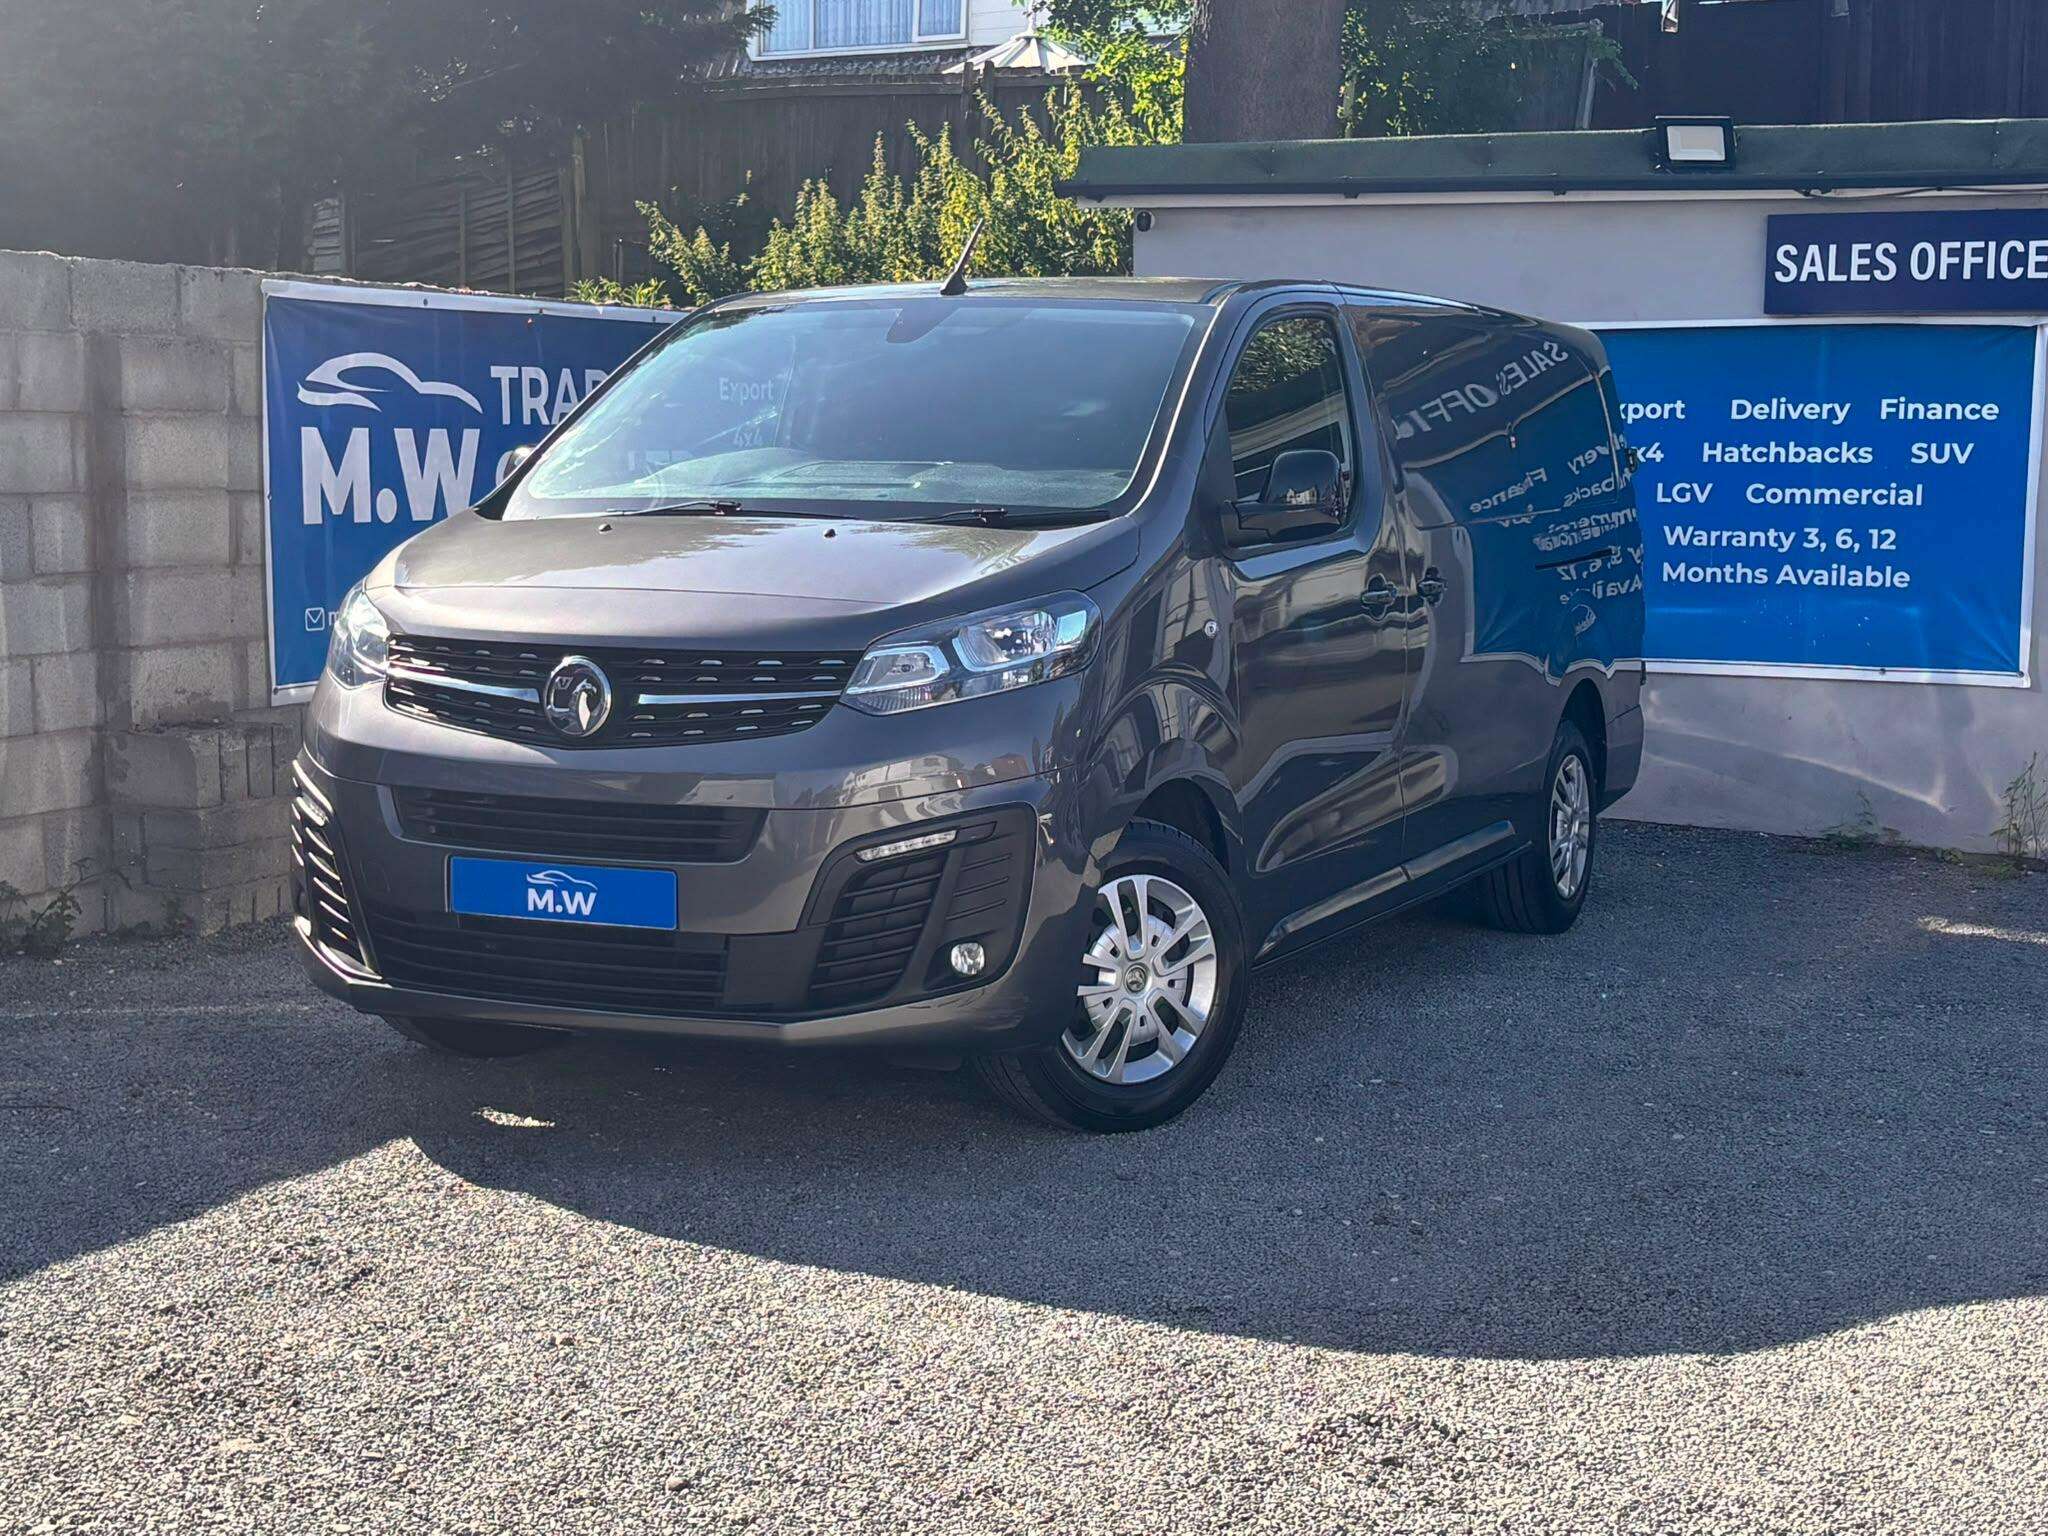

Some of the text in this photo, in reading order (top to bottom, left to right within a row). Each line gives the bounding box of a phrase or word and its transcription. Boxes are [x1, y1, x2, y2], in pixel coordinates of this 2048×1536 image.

[1774, 240, 2048, 283] SALES OFFICE
[719, 376, 775, 407] Export
[1730, 397, 1851, 426] Delivery
[1880, 396, 2000, 421] Finance
[1702, 441, 1874, 464] Hatchbacks
[1910, 442, 1975, 464] SUV
[301, 426, 480, 526] M.W
[1656, 482, 1924, 506] LGV Commercial
[1663, 525, 1797, 553] Warranty
[1802, 527, 1828, 552] 3,
[1835, 528, 1860, 553] 6,
[1868, 528, 1897, 551] 12
[1662, 561, 1911, 588] Months Available
[527, 887, 598, 916] M.W
